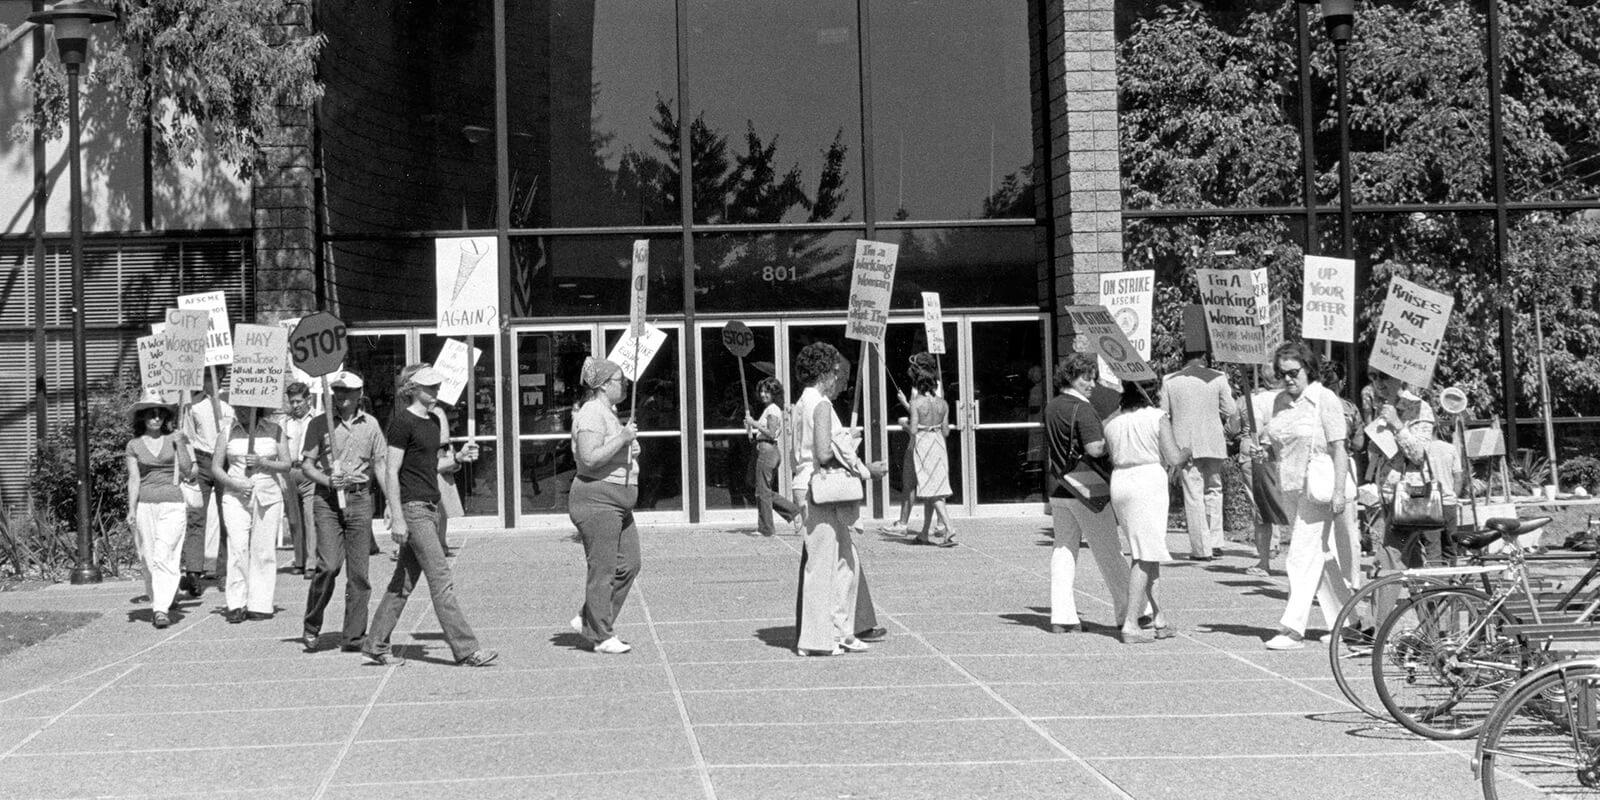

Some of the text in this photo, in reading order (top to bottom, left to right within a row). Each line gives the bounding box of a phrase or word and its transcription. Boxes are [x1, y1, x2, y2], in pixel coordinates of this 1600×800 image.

[762, 266, 796, 281] 801
[856, 257, 893, 280] Working
[1318, 267, 1338, 280] UP
[1103, 276, 1151, 296] ON STRIKE
[1208, 274, 1228, 287] I'm
[1309, 282, 1344, 300] YOUR
[185, 295, 220, 305] AFSCME
[1111, 295, 1141, 306] AFSCME
[1201, 289, 1256, 316] Working
[1306, 300, 1346, 317] OFFER
[169, 310, 201, 329] CITY
[1208, 308, 1255, 327] Woman
[246, 331, 273, 347] HAY
[293, 325, 347, 363] STOP
[723, 330, 753, 346] STOP
[161, 361, 203, 387] STRIKE
[265, 375, 278, 384] Do
